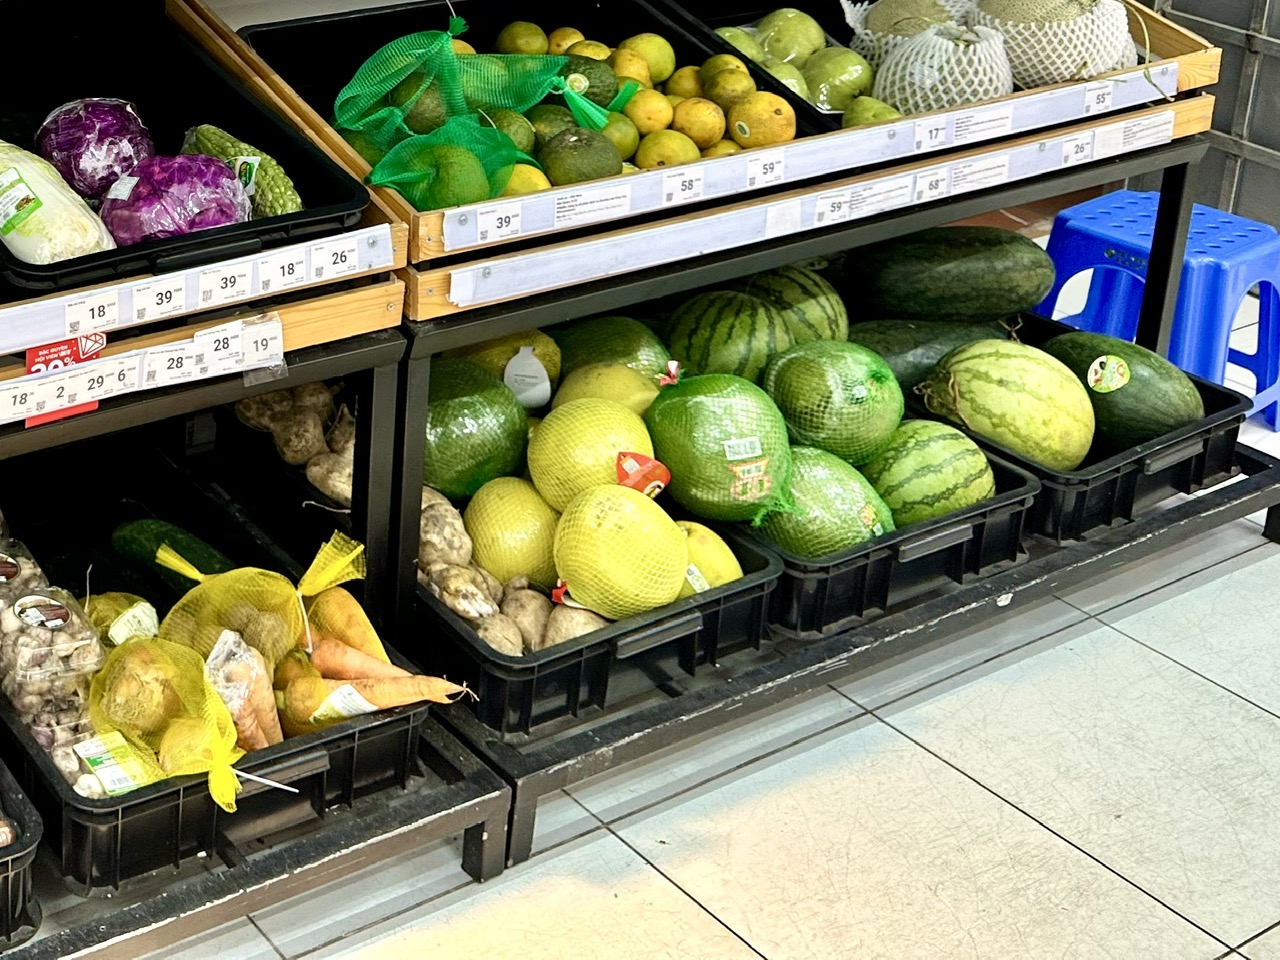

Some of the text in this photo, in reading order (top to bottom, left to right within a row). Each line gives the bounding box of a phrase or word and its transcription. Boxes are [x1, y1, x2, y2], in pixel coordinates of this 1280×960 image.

[1096, 93, 1107, 104] 55
[928, 128, 940, 140] 17
[1074, 143, 1085, 155] 26
[762, 162, 775, 175] 59
[681, 179, 694, 192] 58
[929, 179, 940, 191] 68
[830, 202, 842, 213] 59
[496, 215, 511, 229] 39
[332, 251, 347, 265] 26
[280, 263, 295, 277] 18
[220, 276, 236, 289] 39
[156, 290, 172, 305] 39
[89, 305, 106, 320] 18
[214, 337, 230, 351] 28
[253, 338, 268, 352] 19
[167, 356, 184, 370] 28
[118, 370, 126, 382] 6
[87, 375, 104, 391] 29
[11, 393, 28, 406] 18
